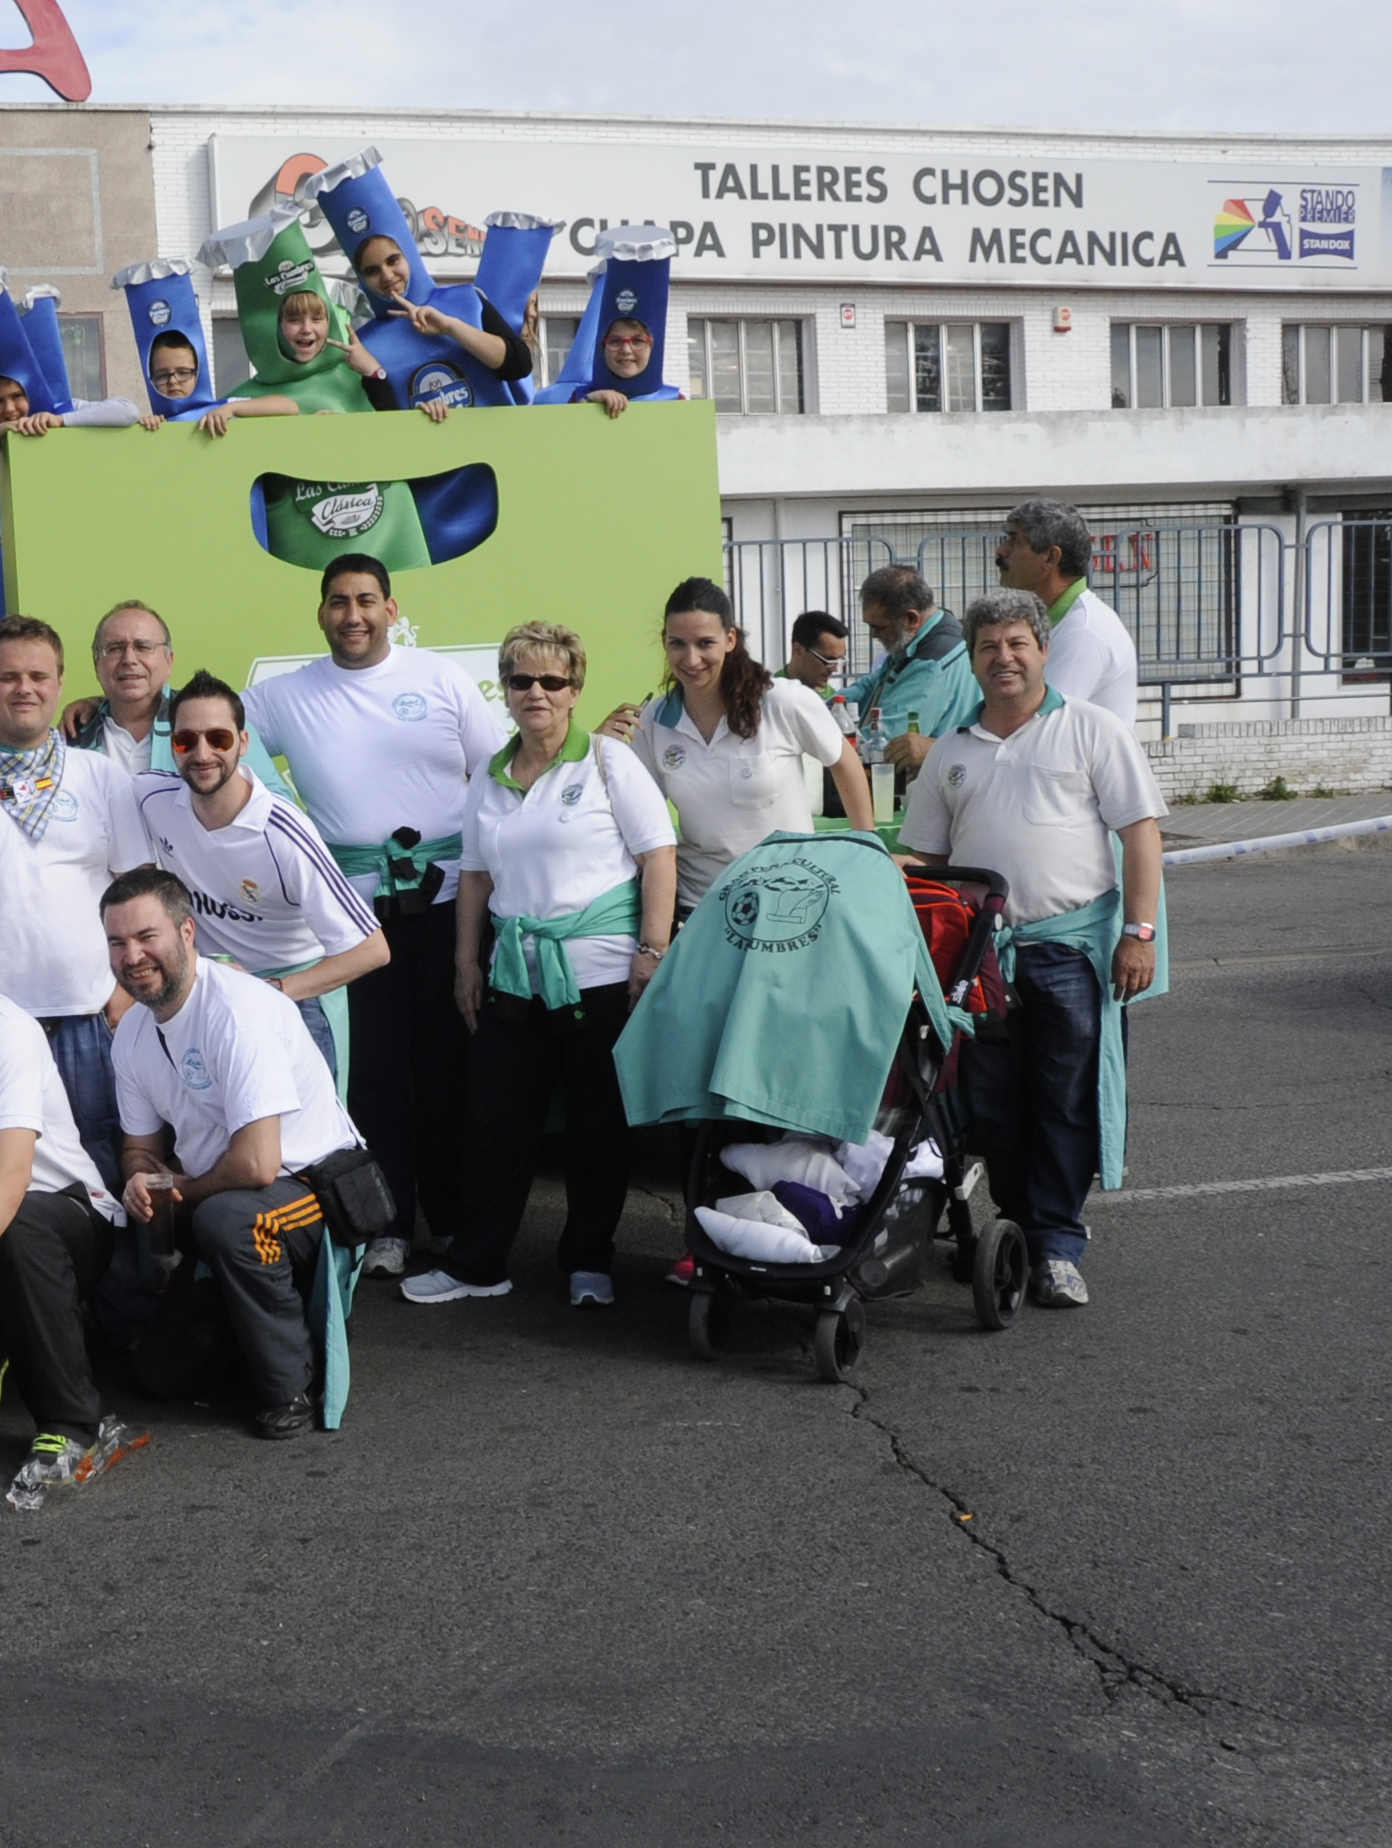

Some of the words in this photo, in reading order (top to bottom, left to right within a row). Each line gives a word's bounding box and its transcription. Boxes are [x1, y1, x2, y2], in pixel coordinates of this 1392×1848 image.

[694, 161, 890, 204] TALLERES
[912, 166, 1085, 210] CHOSEN
[1298, 208, 1356, 225] PREMIER
[569, 216, 727, 259] CPA
[750, 221, 946, 264] PINTURA
[968, 225, 1188, 268] MECANICA
[1302, 238, 1351, 251] STANDOX
[295, 482, 323, 502] Las
